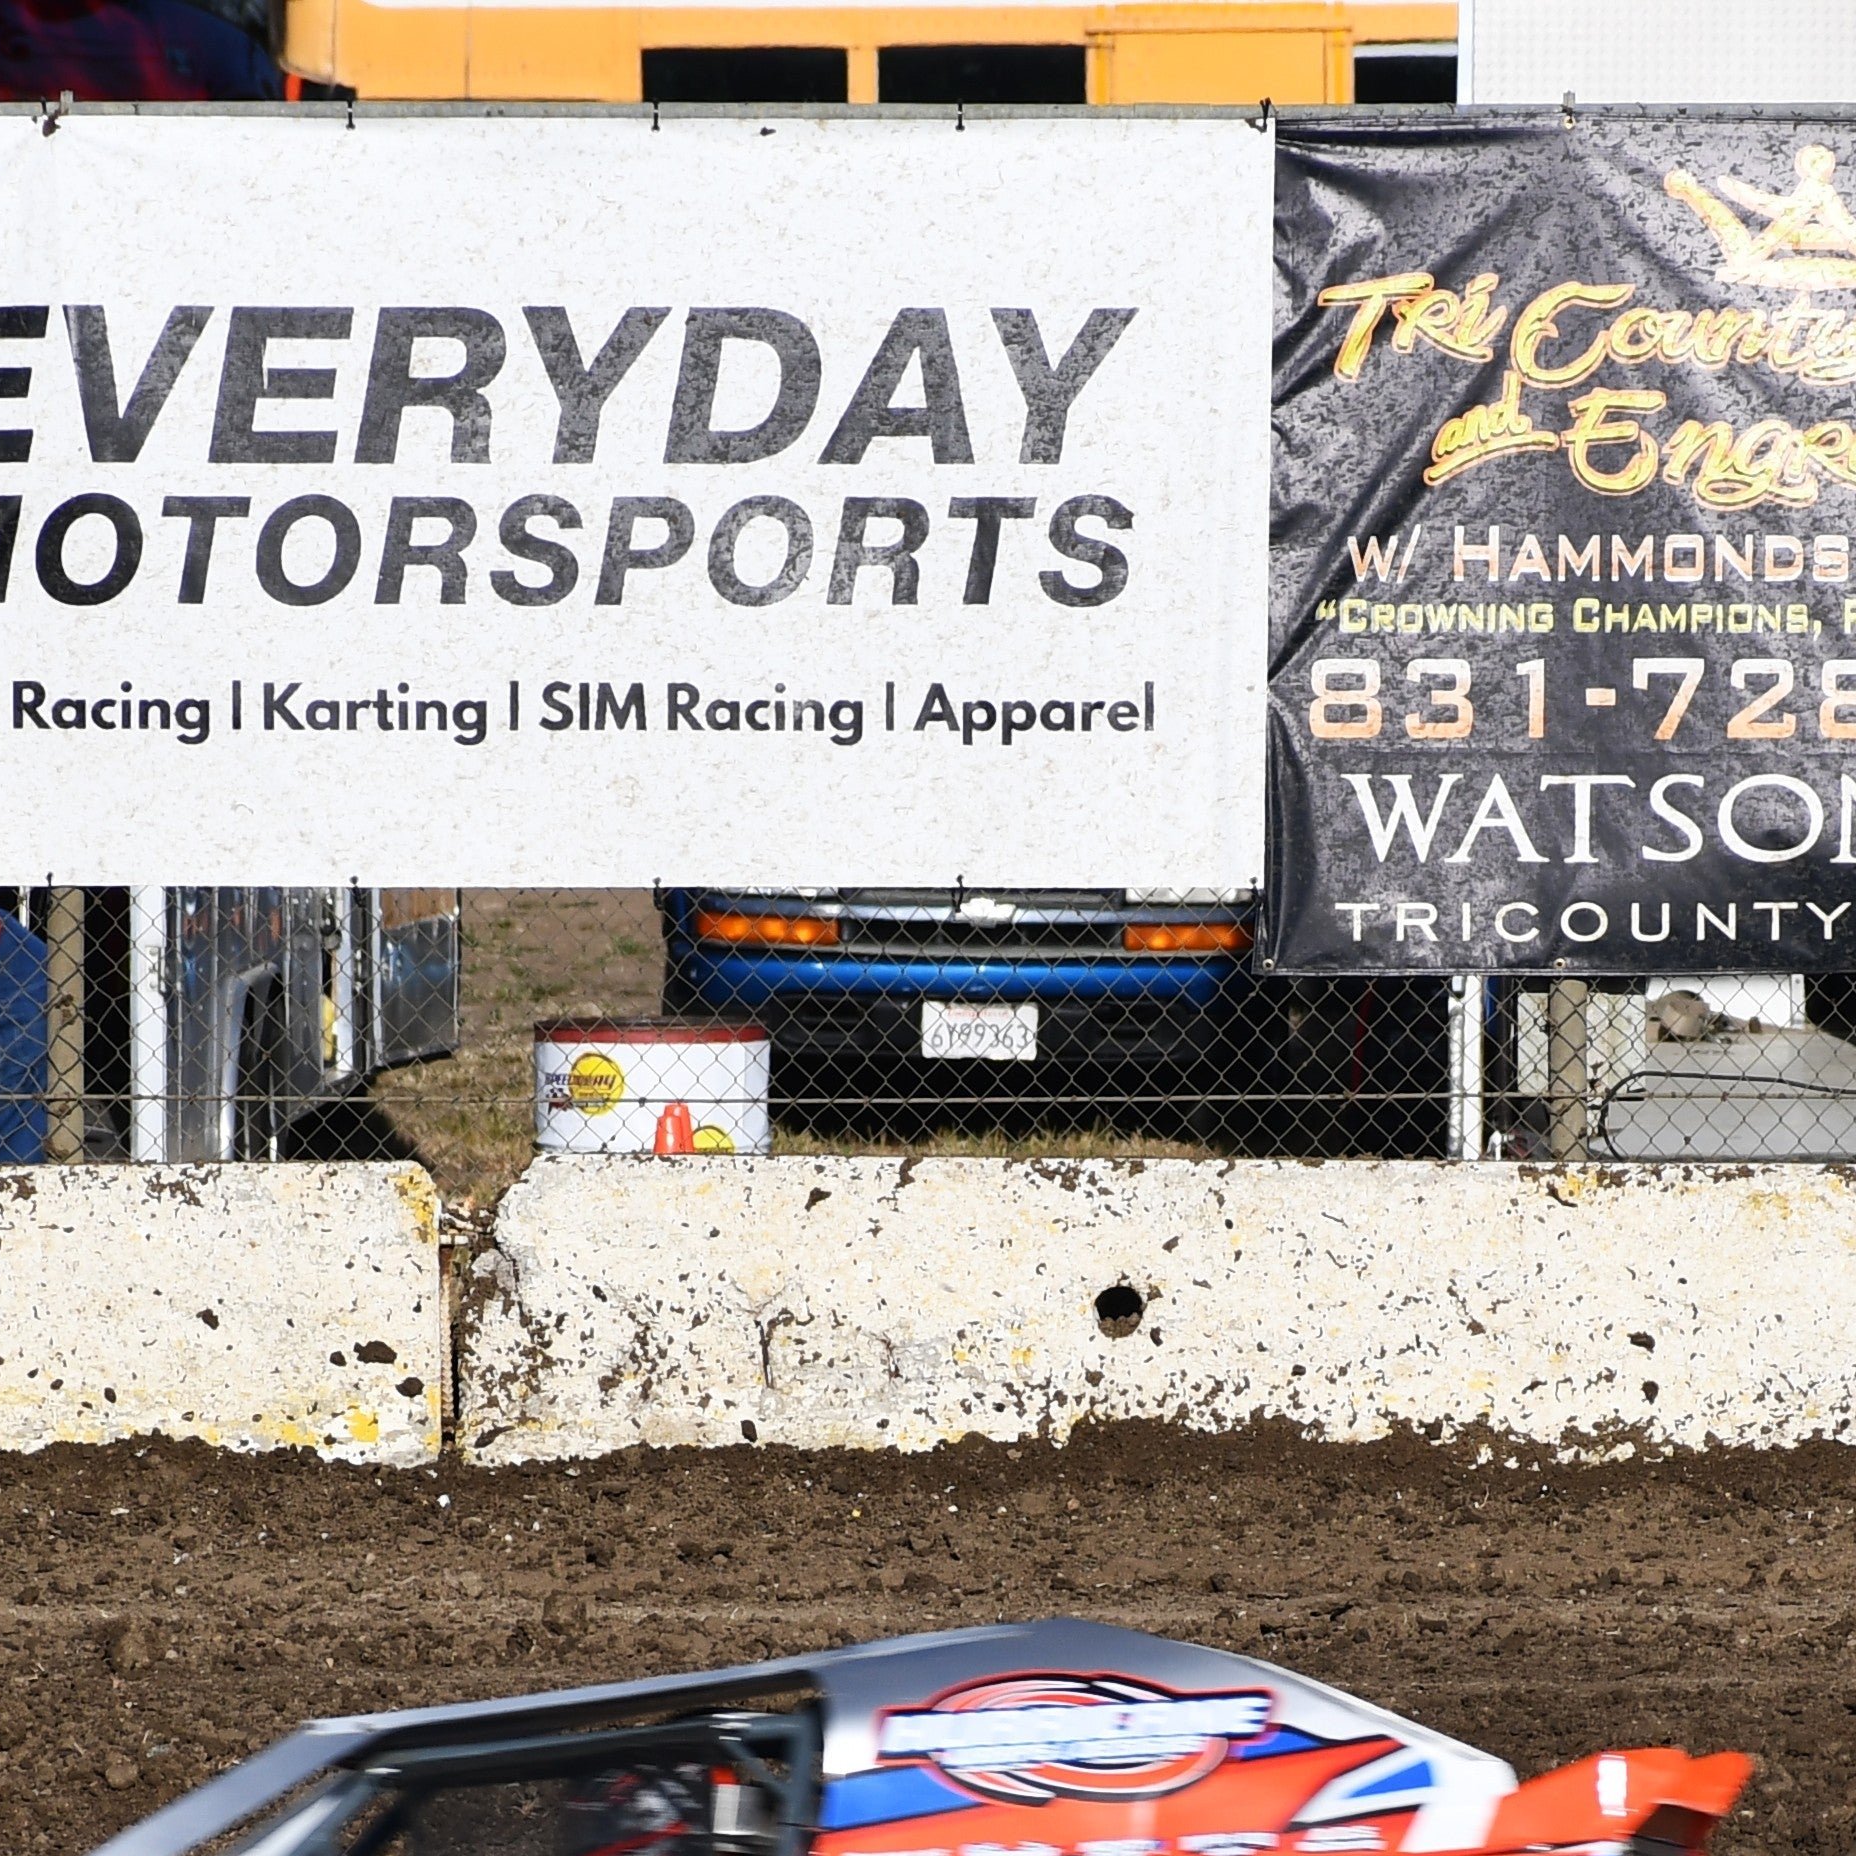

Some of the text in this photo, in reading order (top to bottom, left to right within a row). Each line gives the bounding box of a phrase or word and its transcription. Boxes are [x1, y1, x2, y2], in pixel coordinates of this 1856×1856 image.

[1451, 525, 1851, 585] HAMMONDS
[12, 680, 211, 746] Racing
[263, 680, 488, 746] Karting
[540, 681, 648, 732] SIM
[667, 680, 864, 746] Racing
[914, 680, 1156, 746] Apparel
